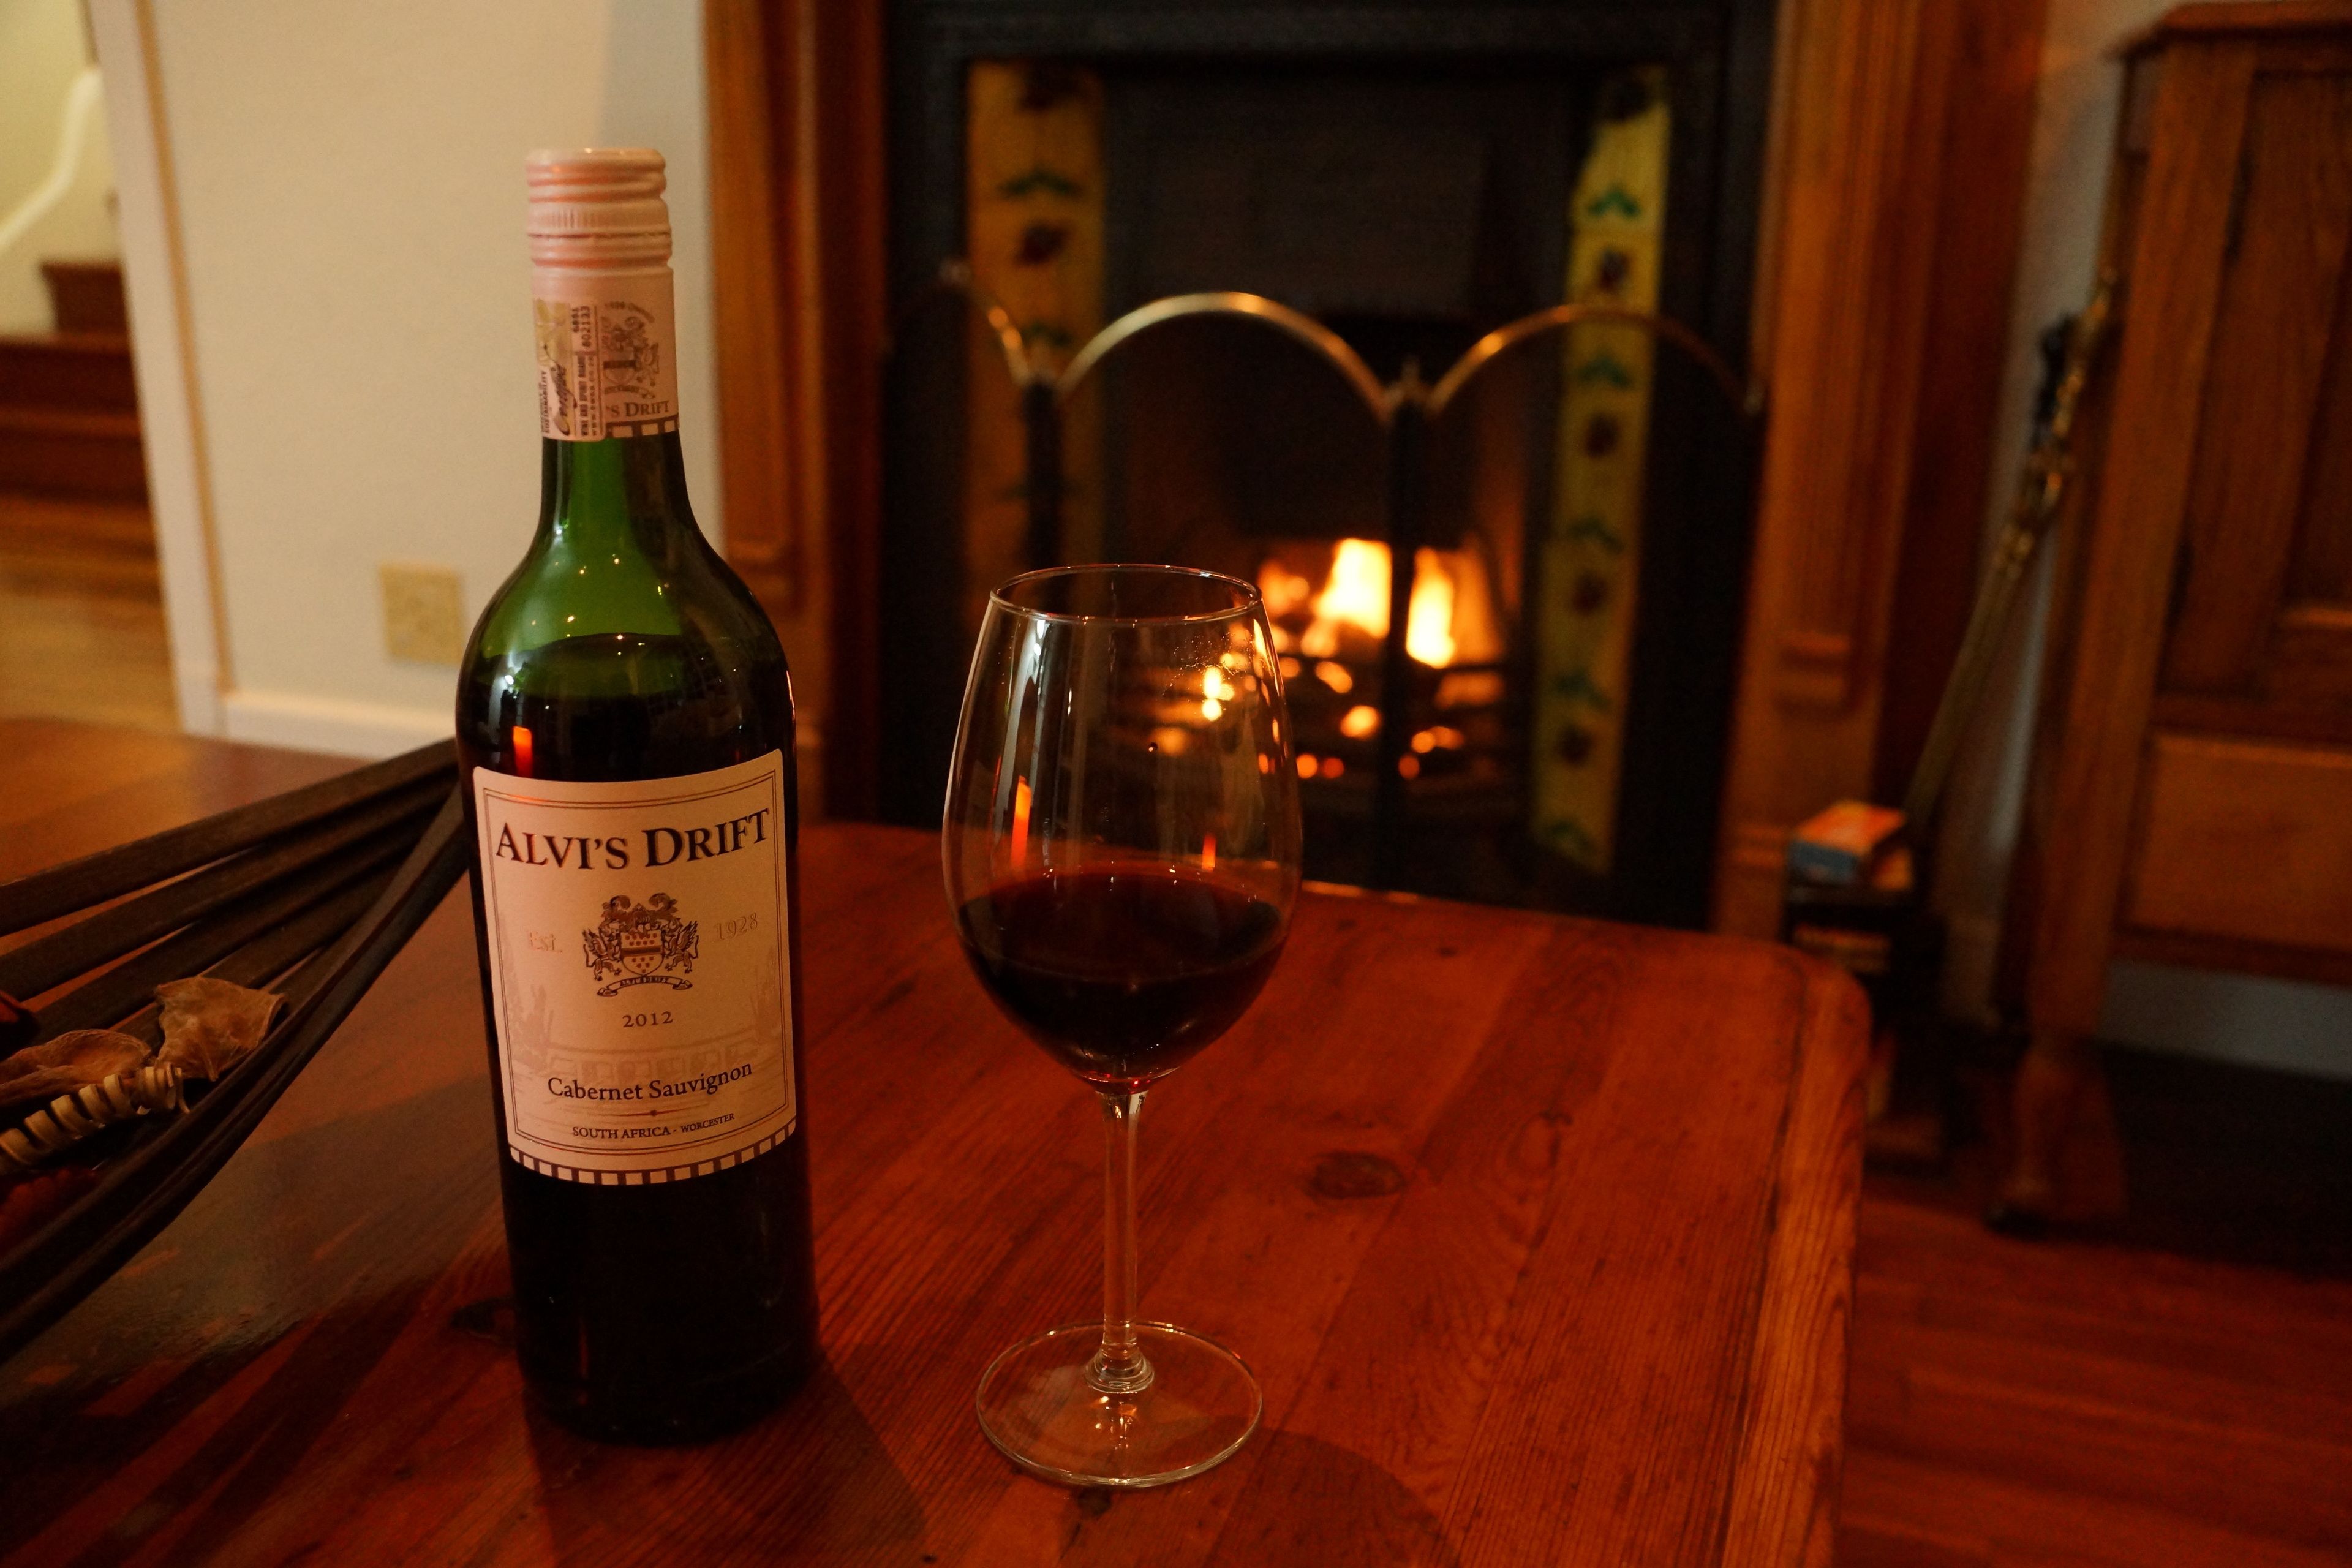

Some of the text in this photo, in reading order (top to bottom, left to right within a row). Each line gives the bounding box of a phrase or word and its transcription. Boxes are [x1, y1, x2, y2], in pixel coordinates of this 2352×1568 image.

[624, 401, 669, 417] DRIFT
[495, 807, 770, 870] ALVI'S DRIFT
[712, 911, 758, 942] 1928
[622, 1011, 674, 1028] 2012
[547, 1062, 753, 1101] Cabernet Sauvignon
[572, 1126, 619, 1139] SOUTH
[621, 1126, 672, 1139] AFRICA
[680, 1112, 736, 1133] WORCESTER
